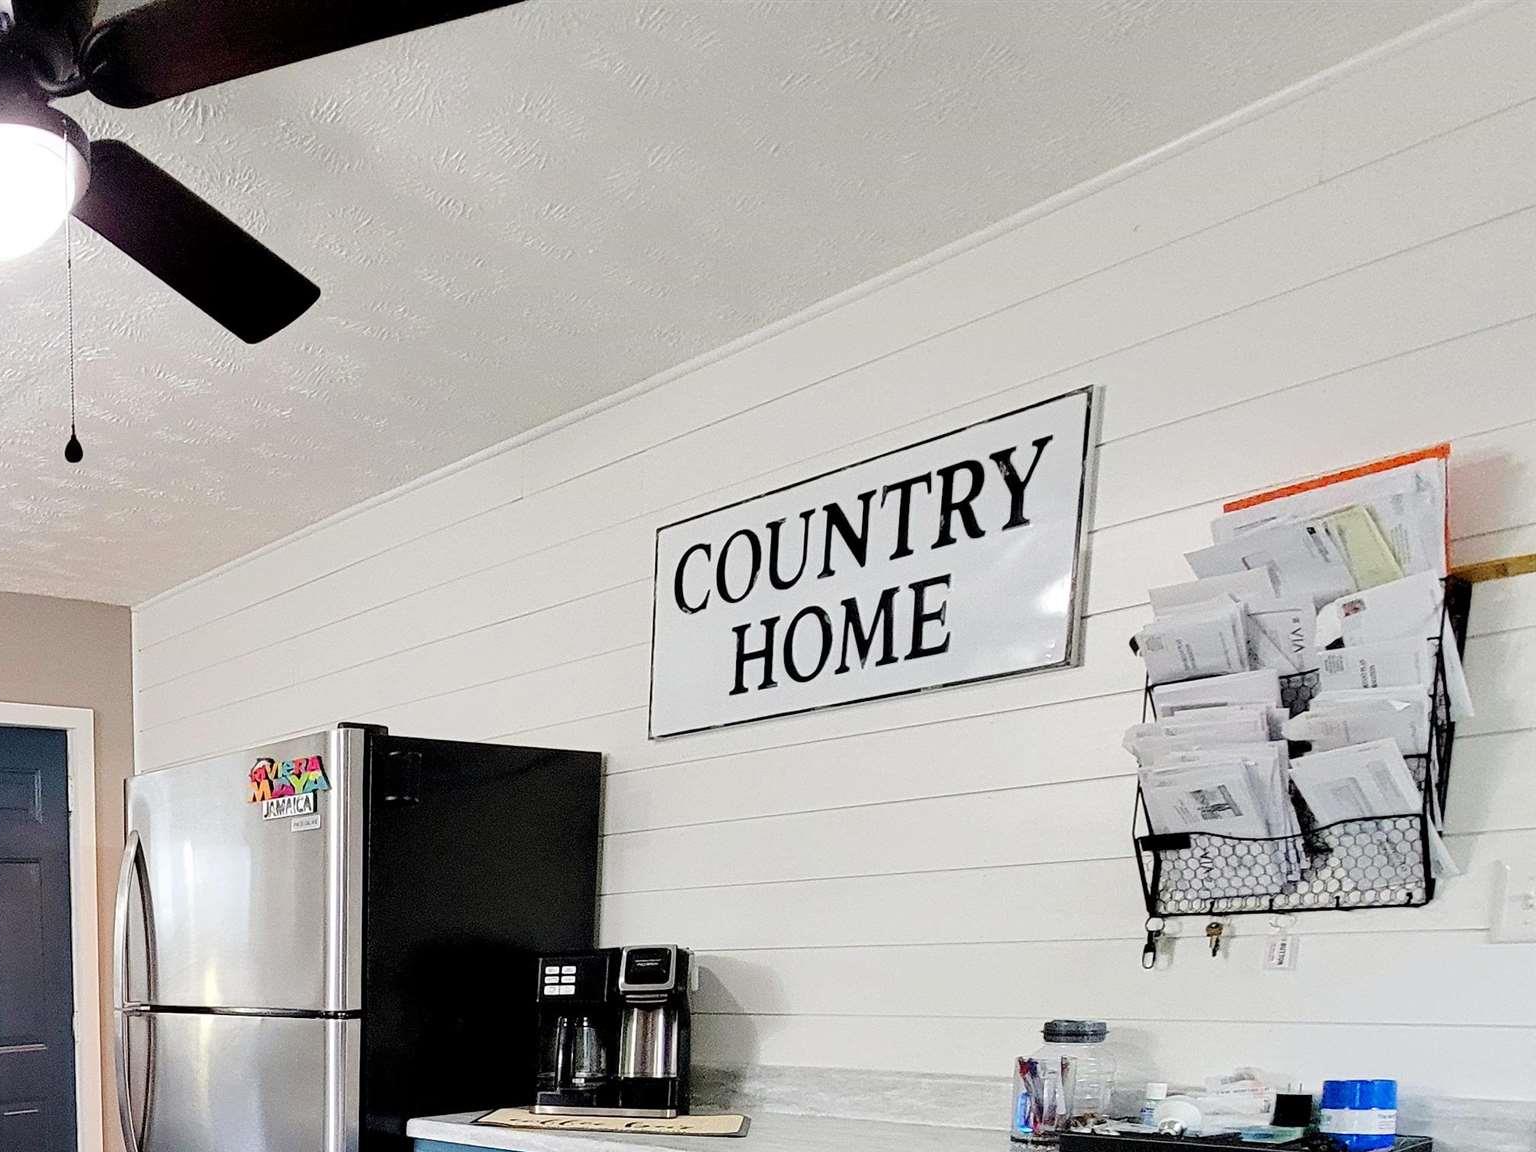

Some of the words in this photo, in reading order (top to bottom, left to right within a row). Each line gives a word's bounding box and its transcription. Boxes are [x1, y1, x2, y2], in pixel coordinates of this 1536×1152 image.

[674, 435, 1053, 614] COUNTRY
[729, 574, 952, 696] HOME
[264, 795, 312, 818] JAMAICA
